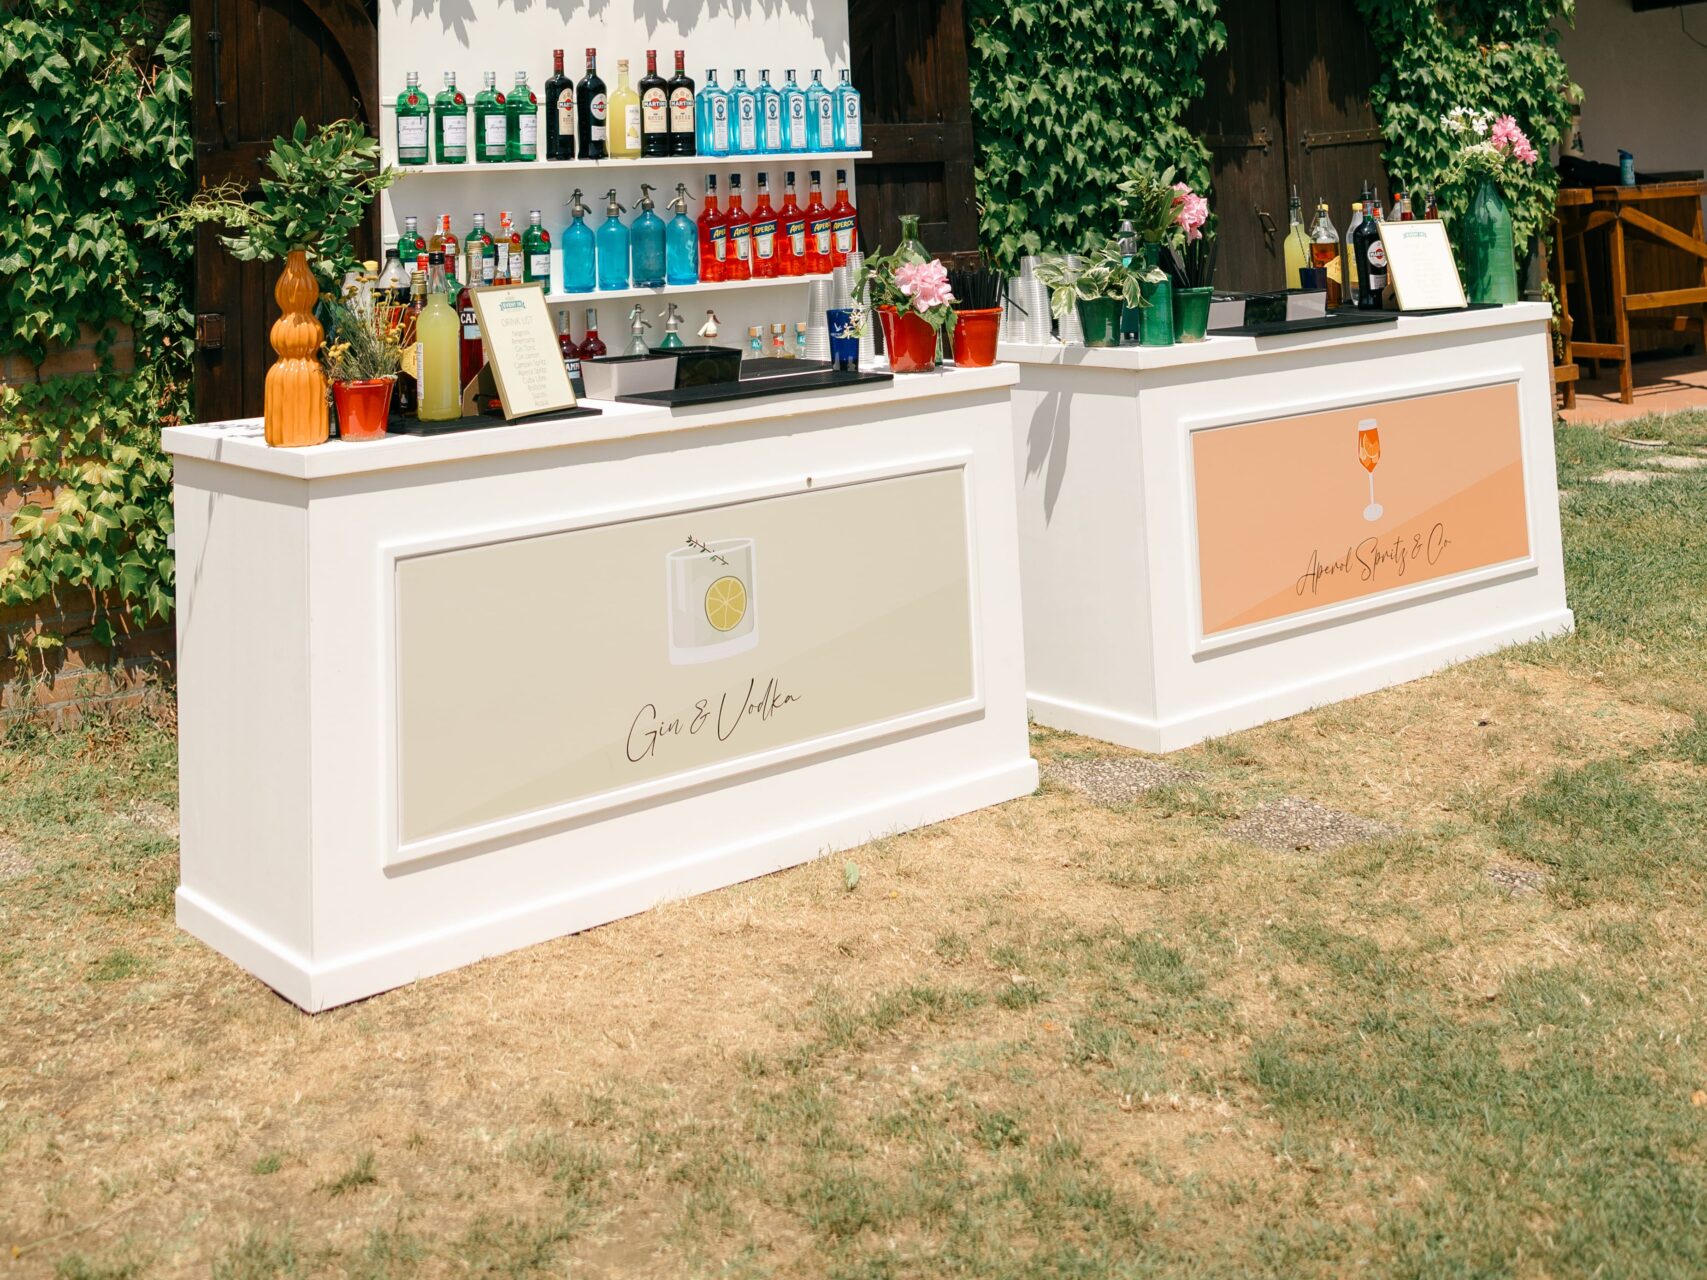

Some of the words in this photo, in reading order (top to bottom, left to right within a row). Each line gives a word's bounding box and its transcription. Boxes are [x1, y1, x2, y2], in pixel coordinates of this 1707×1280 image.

[754, 224, 775, 235] APEROL
[833, 220, 854, 231] APEROL
[1296, 547, 1354, 596] Aperol
[1355, 536, 1408, 582] Spritz
[1411, 533, 1423, 560] &
[1427, 522, 1452, 566] Co
[626, 703, 684, 763] Gin
[689, 698, 711, 735] &
[717, 677, 802, 742] Vodka
